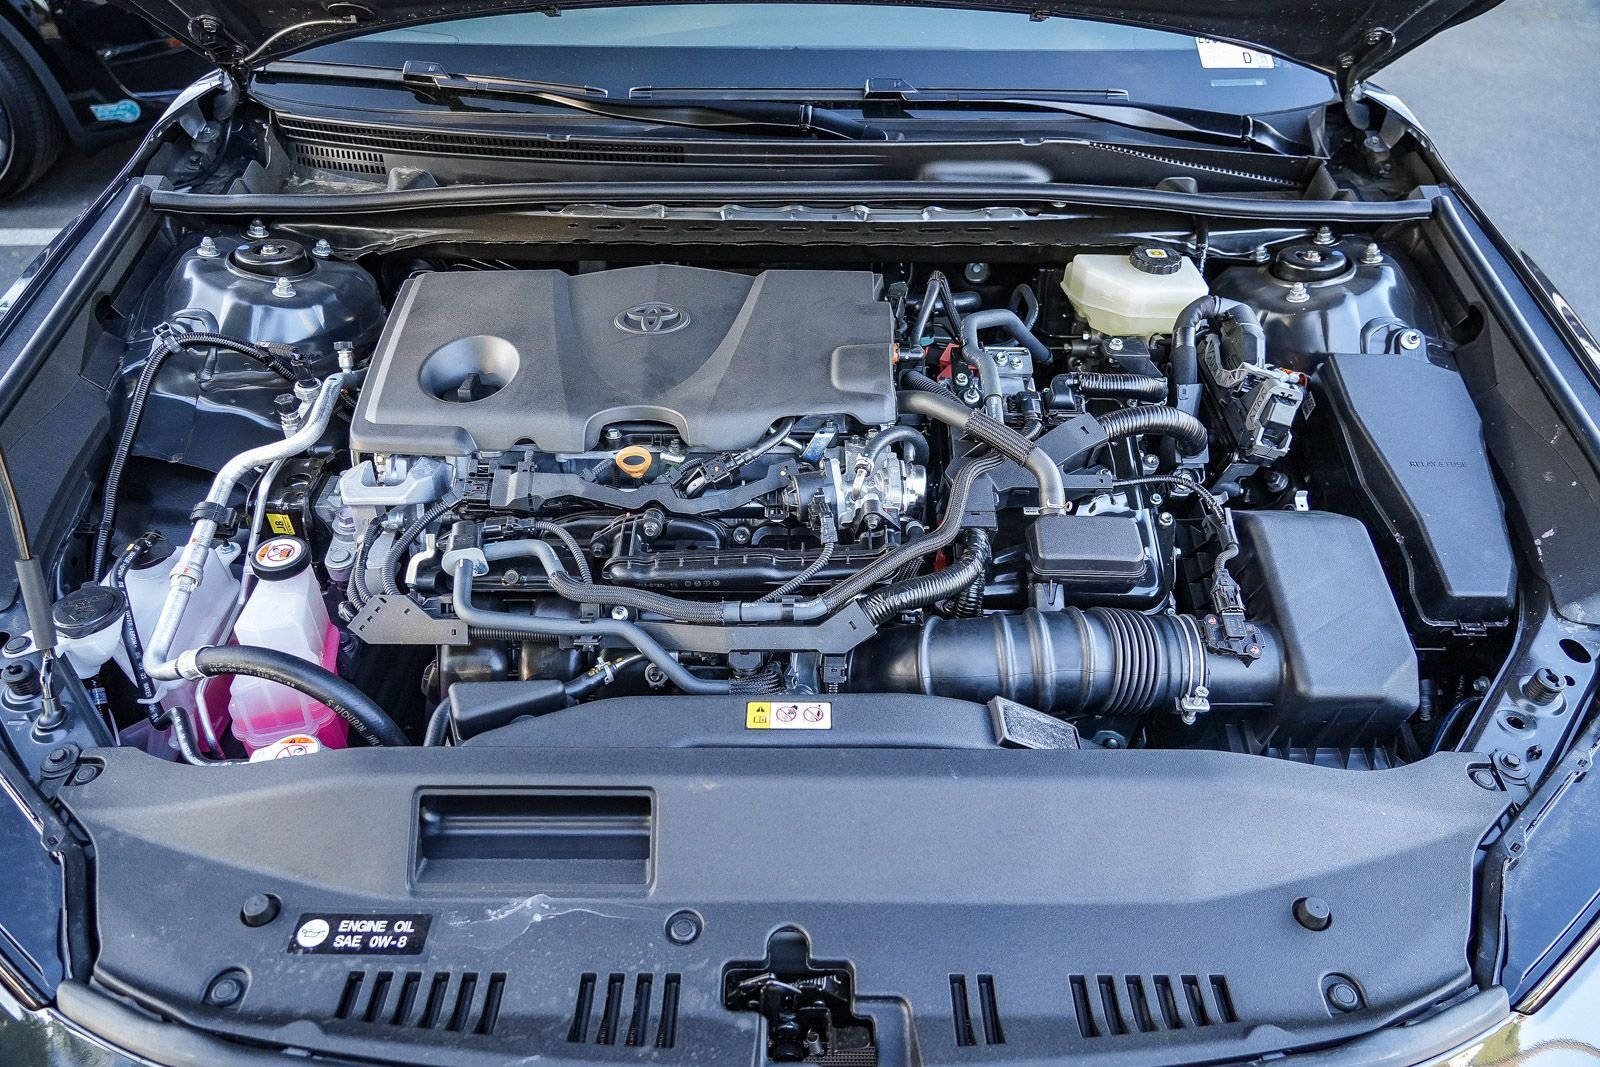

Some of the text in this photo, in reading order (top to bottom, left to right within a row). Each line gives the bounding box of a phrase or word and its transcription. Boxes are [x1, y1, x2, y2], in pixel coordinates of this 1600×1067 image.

[338, 920, 415, 933] ENGINE OIL
[333, 935, 408, 948] SAE 0W-8
